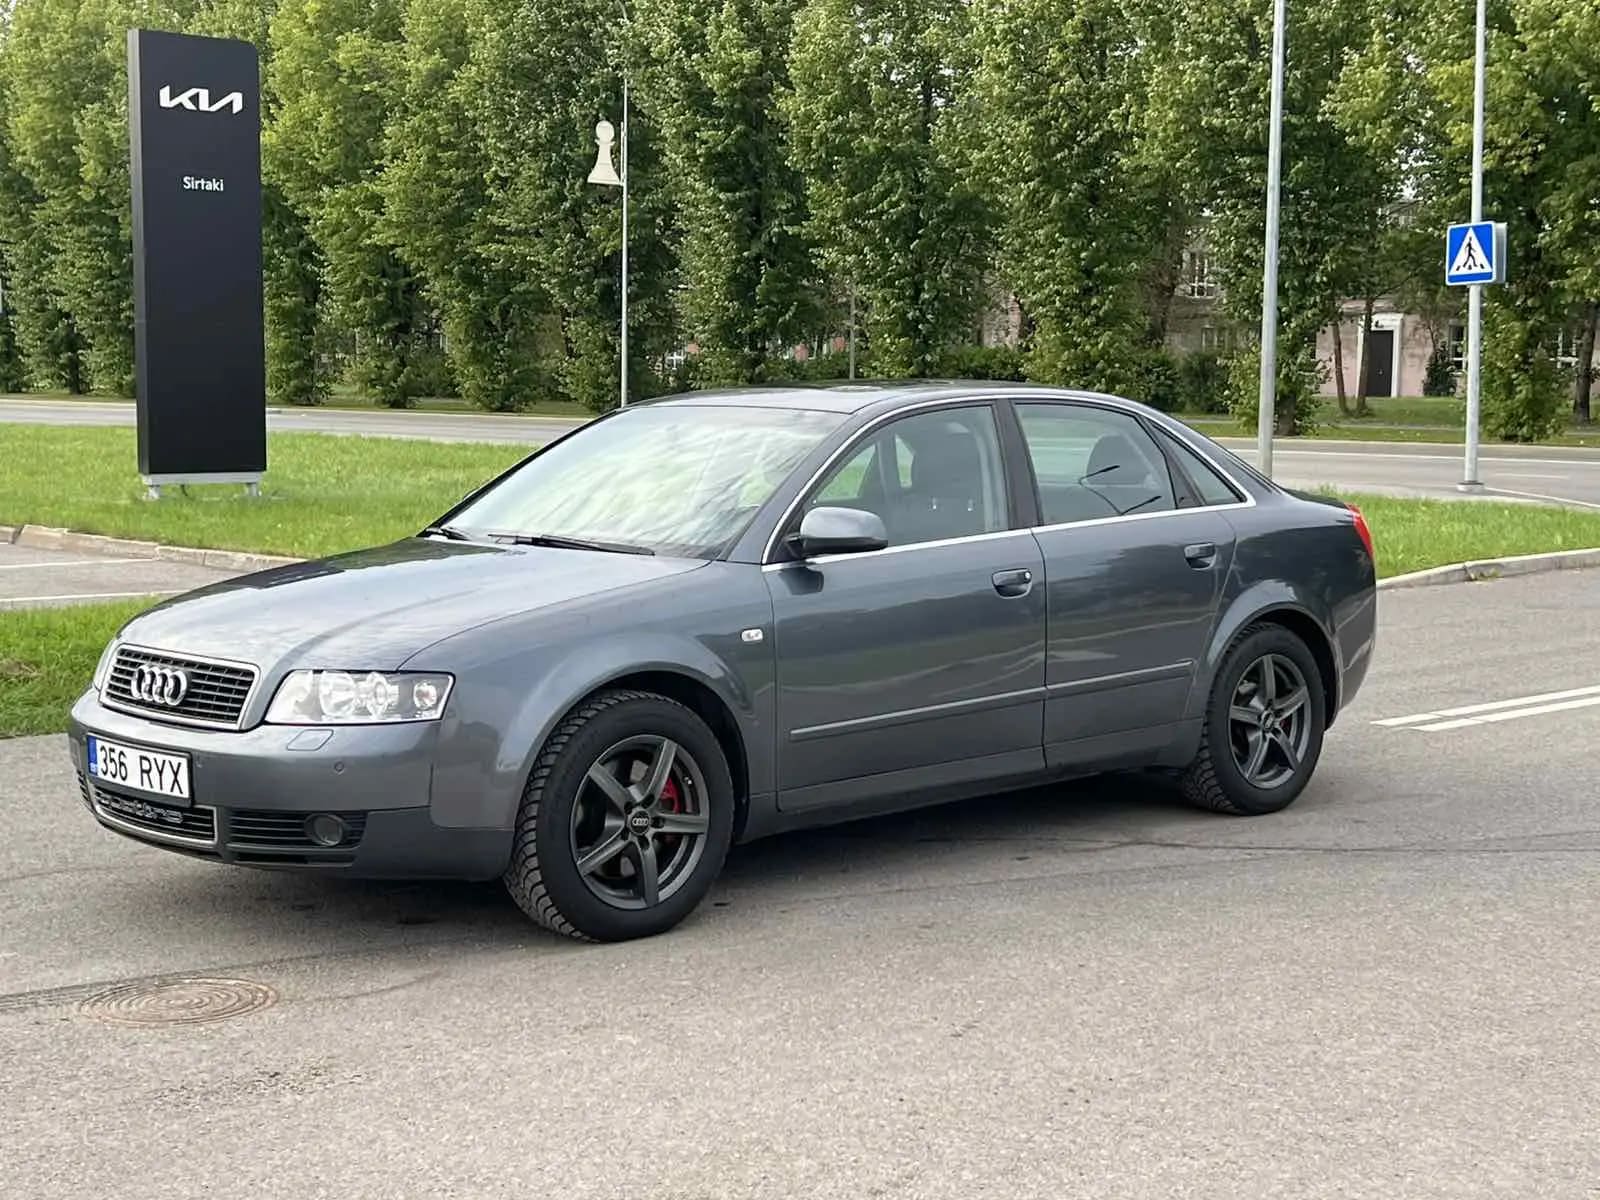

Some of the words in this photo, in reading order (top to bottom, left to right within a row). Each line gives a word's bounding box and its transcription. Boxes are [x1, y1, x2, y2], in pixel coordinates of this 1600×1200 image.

[159, 85, 243, 114] KIA
[183, 176, 224, 191] Sirtaki
[100, 745, 128, 781] 356
[139, 755, 184, 795] RYX
